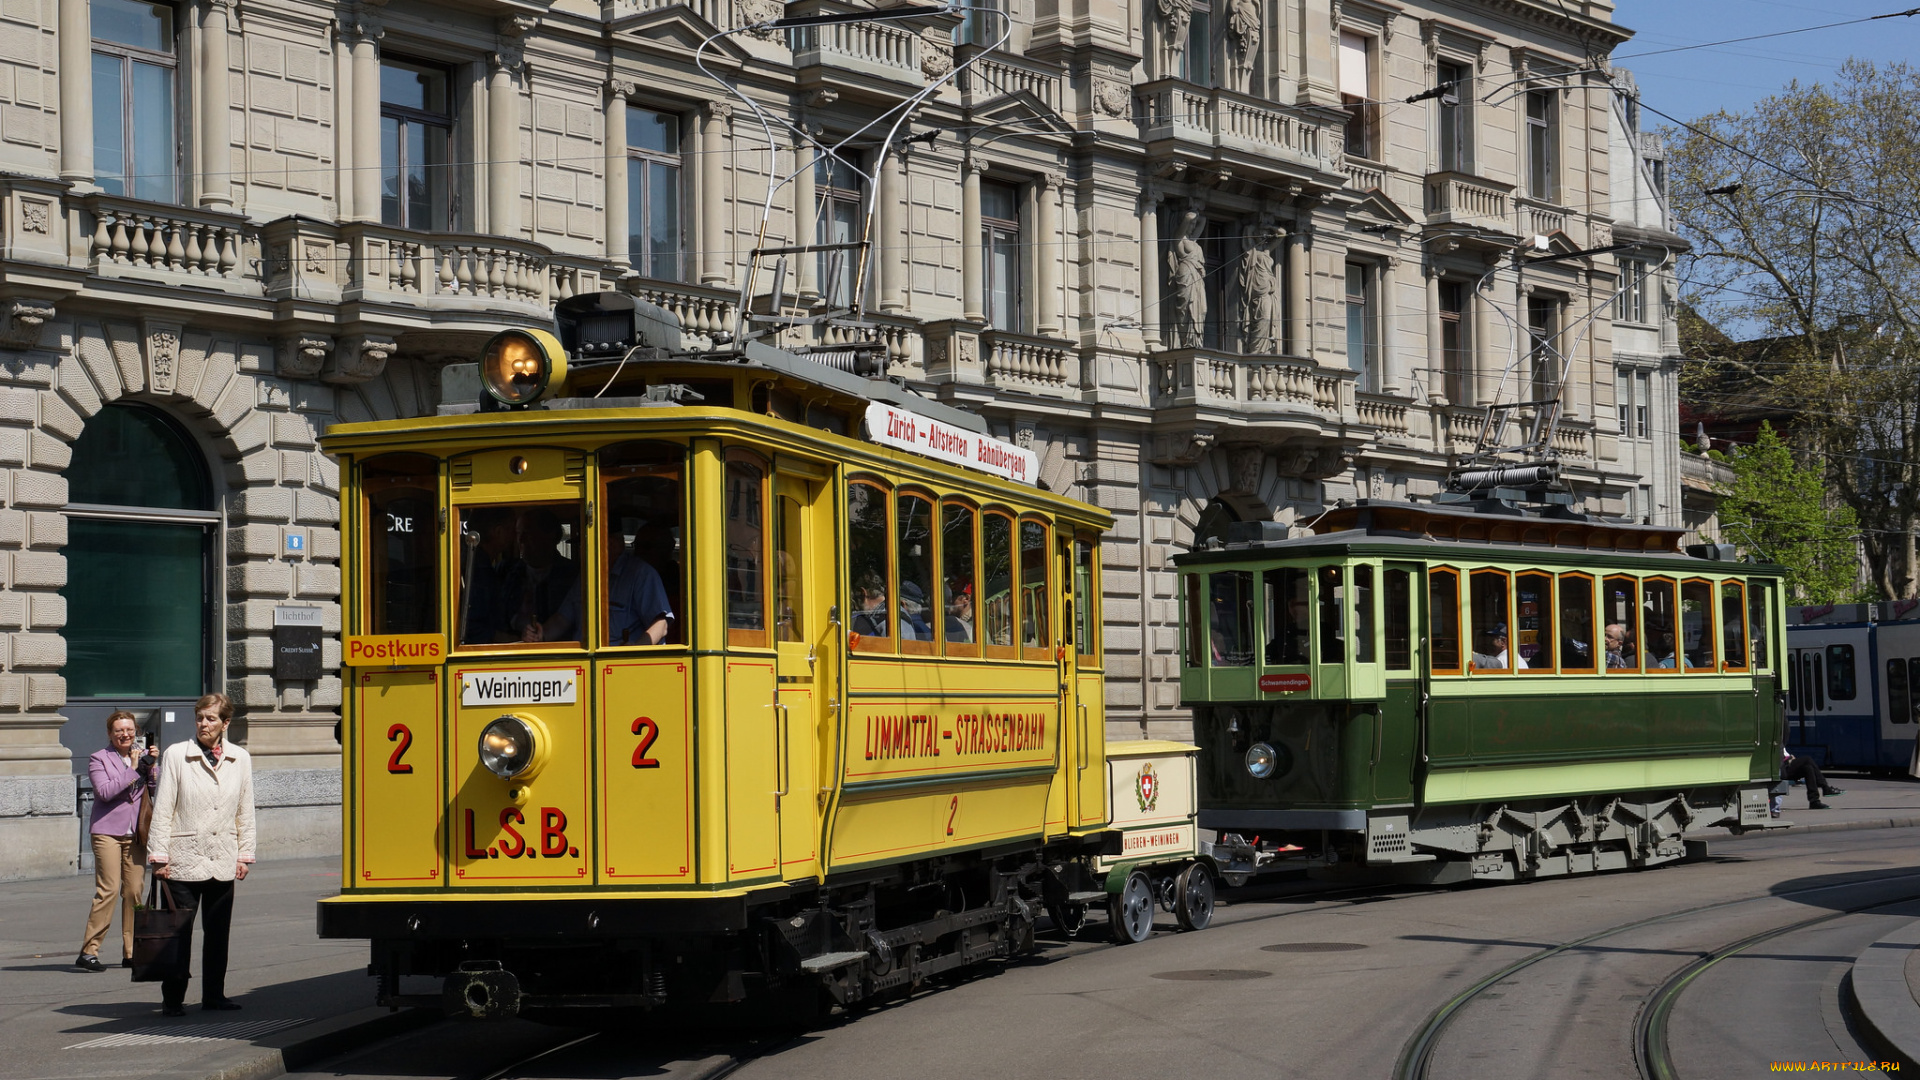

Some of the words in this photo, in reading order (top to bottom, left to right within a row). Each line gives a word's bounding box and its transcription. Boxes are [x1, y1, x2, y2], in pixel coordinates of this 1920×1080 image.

[887, 410, 916, 443] Zürich
[928, 423, 968, 457] Altstetten
[978, 438, 1026, 480] Bahnübergang
[292, 537, 299, 548] 8
[282, 611, 315, 621] lichthof
[350, 639, 440, 659] Postkurs
[1524, 649, 1531, 657] 17
[475, 676, 562, 702] Weiningen
[1260, 679, 1309, 687] Schwamendingen
[387, 723, 414, 774] 2
[630, 716, 660, 769] 2
[946, 795, 959, 836] 2
[464, 806, 579, 860] L.S.B.
